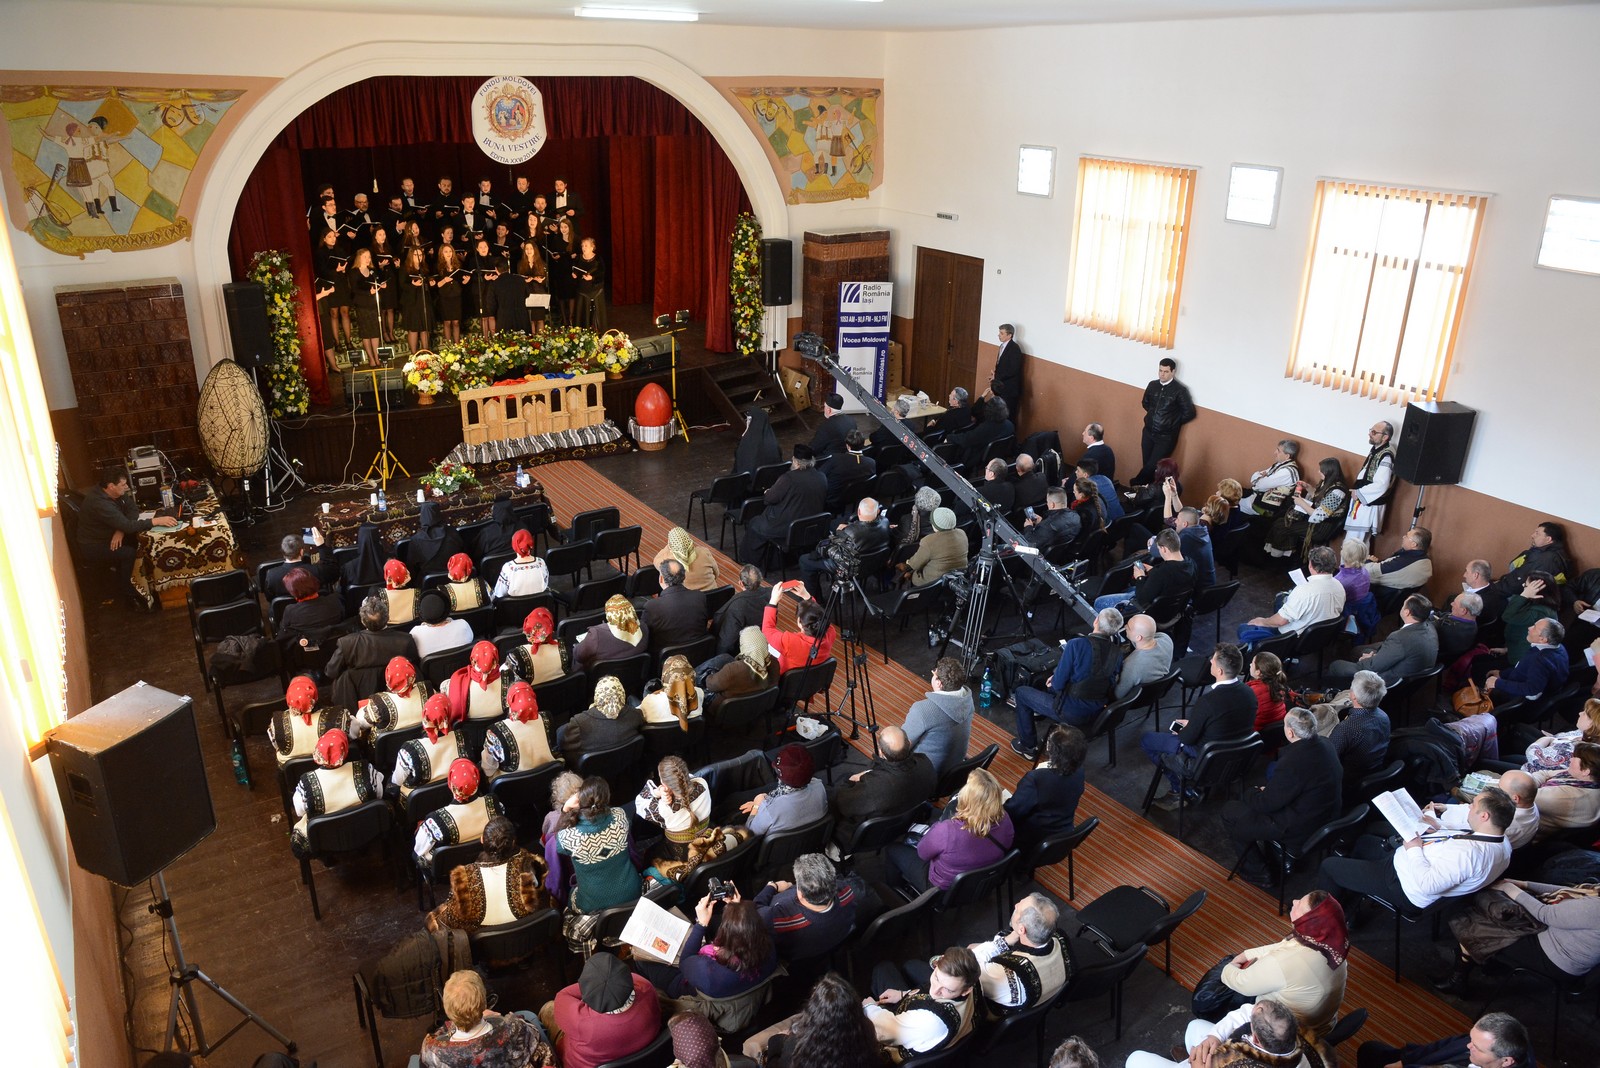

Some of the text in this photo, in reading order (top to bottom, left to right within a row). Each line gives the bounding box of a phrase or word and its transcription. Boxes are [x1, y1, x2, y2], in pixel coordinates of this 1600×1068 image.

[479, 75, 537, 97] FUNDU MOLDOVEI
[483, 133, 543, 152] BUNA VESTIRE
[523, 148, 537, 161] 2016
